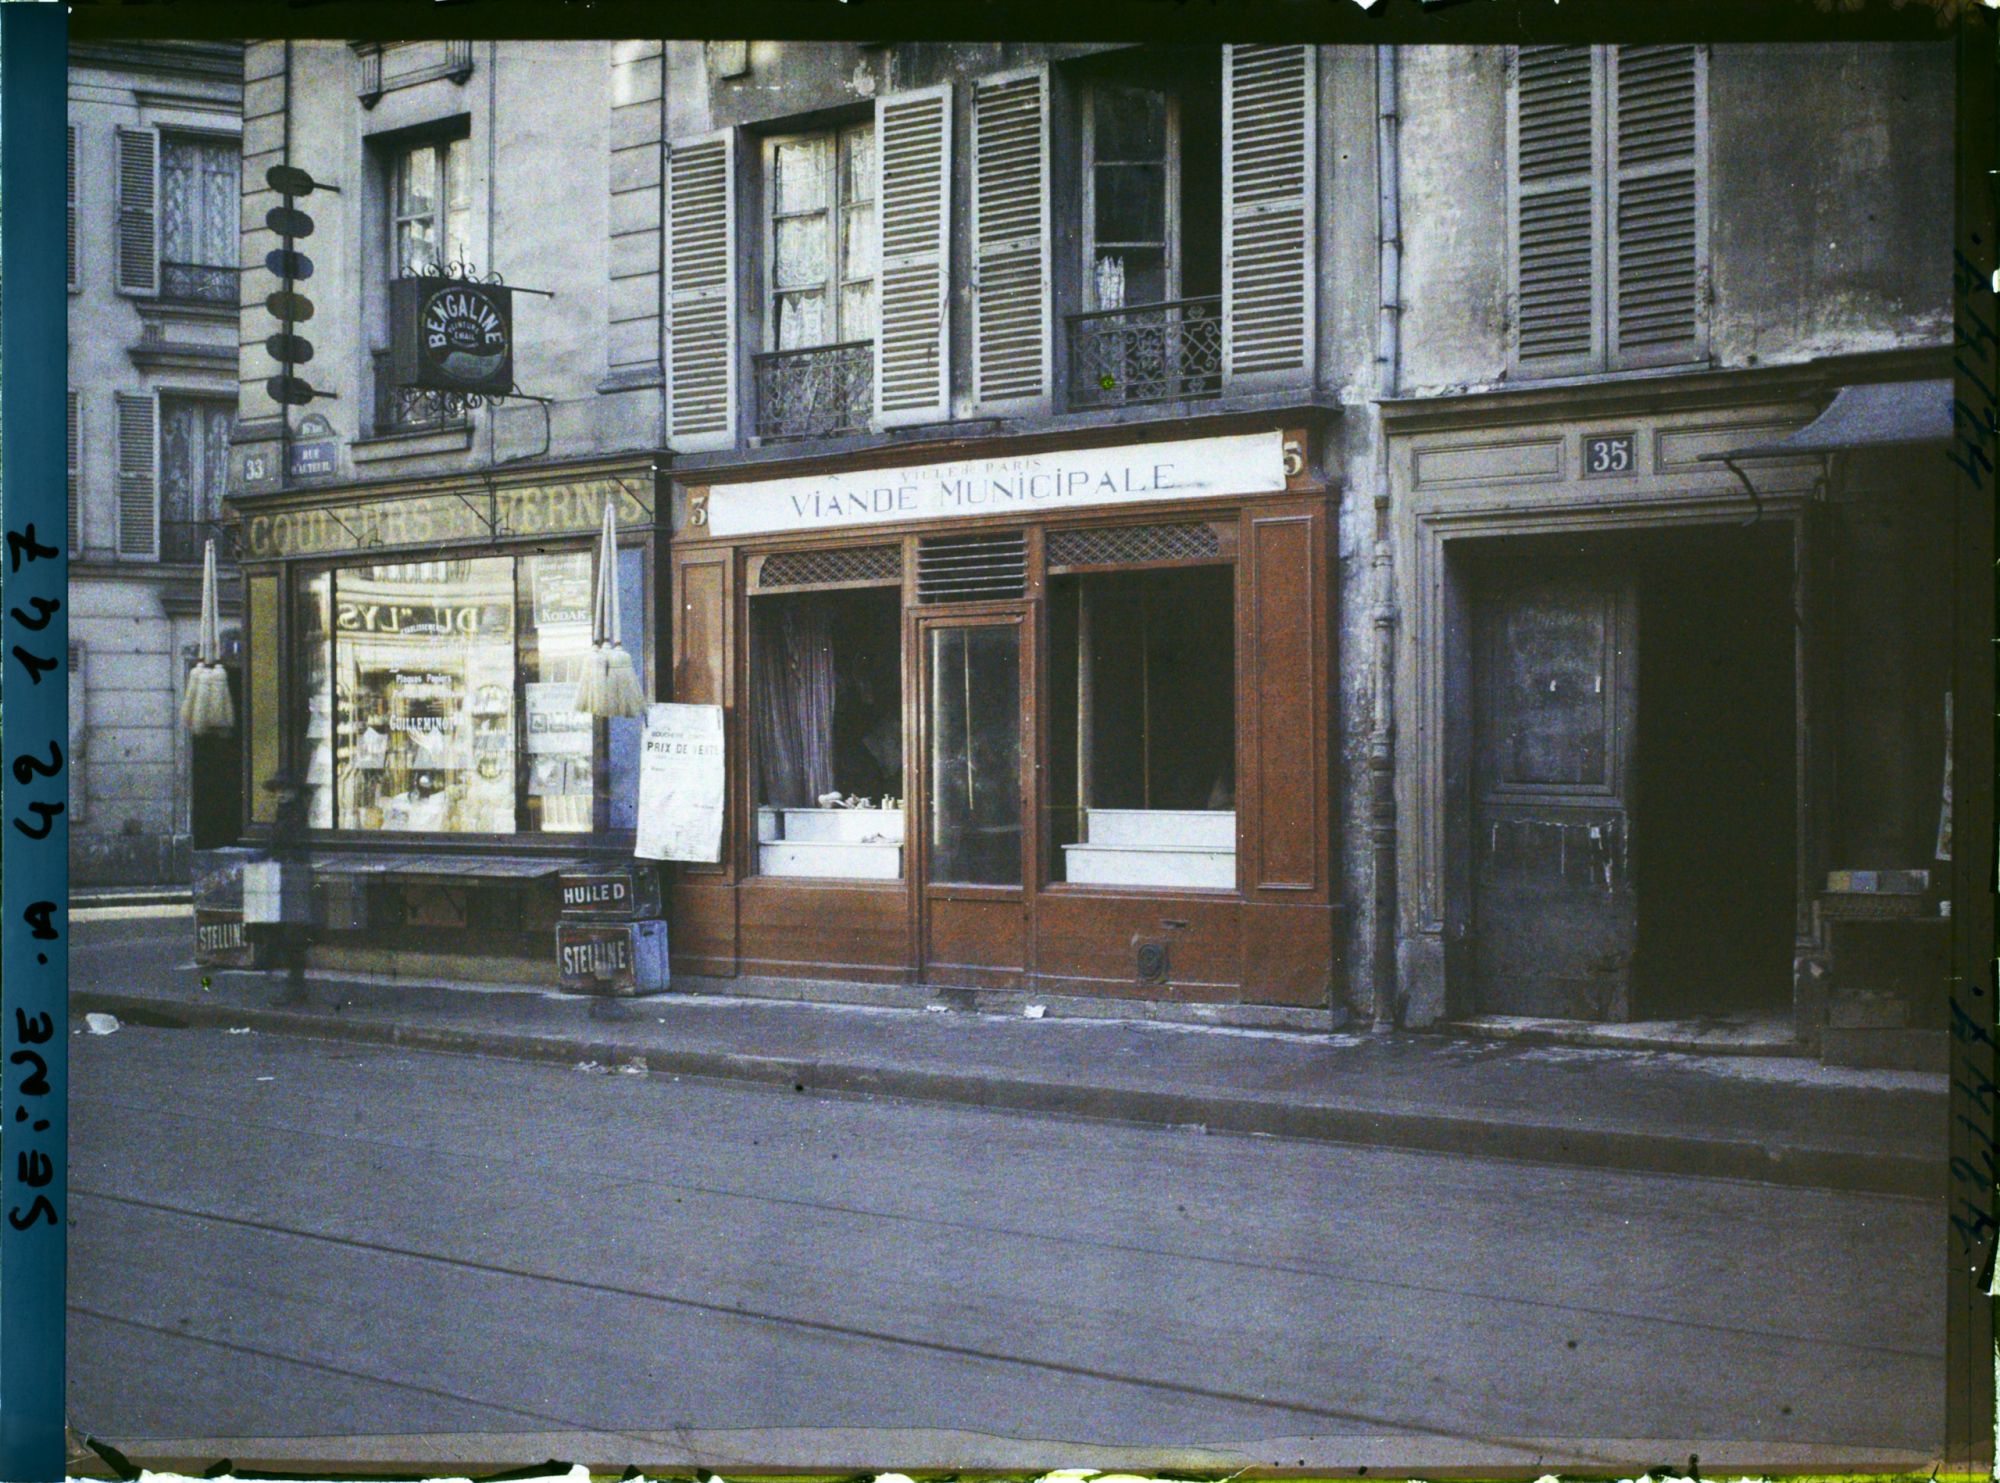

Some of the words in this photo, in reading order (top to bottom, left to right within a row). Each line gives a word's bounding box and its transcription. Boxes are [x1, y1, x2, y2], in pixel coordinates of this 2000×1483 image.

[427, 294, 503, 348] BENGALINE
[245, 459, 264, 480] 33
[1593, 440, 1628, 471] 35
[7, 523, 60, 685] 147
[541, 608, 587, 623] KODAK
[647, 741, 671, 754] PRIX
[676, 744, 688, 755] DE
[13, 740, 65, 840] 42
[563, 884, 610, 904] HUILE
[613, 883, 625, 900] D
[563, 940, 626, 976] STELLINE
